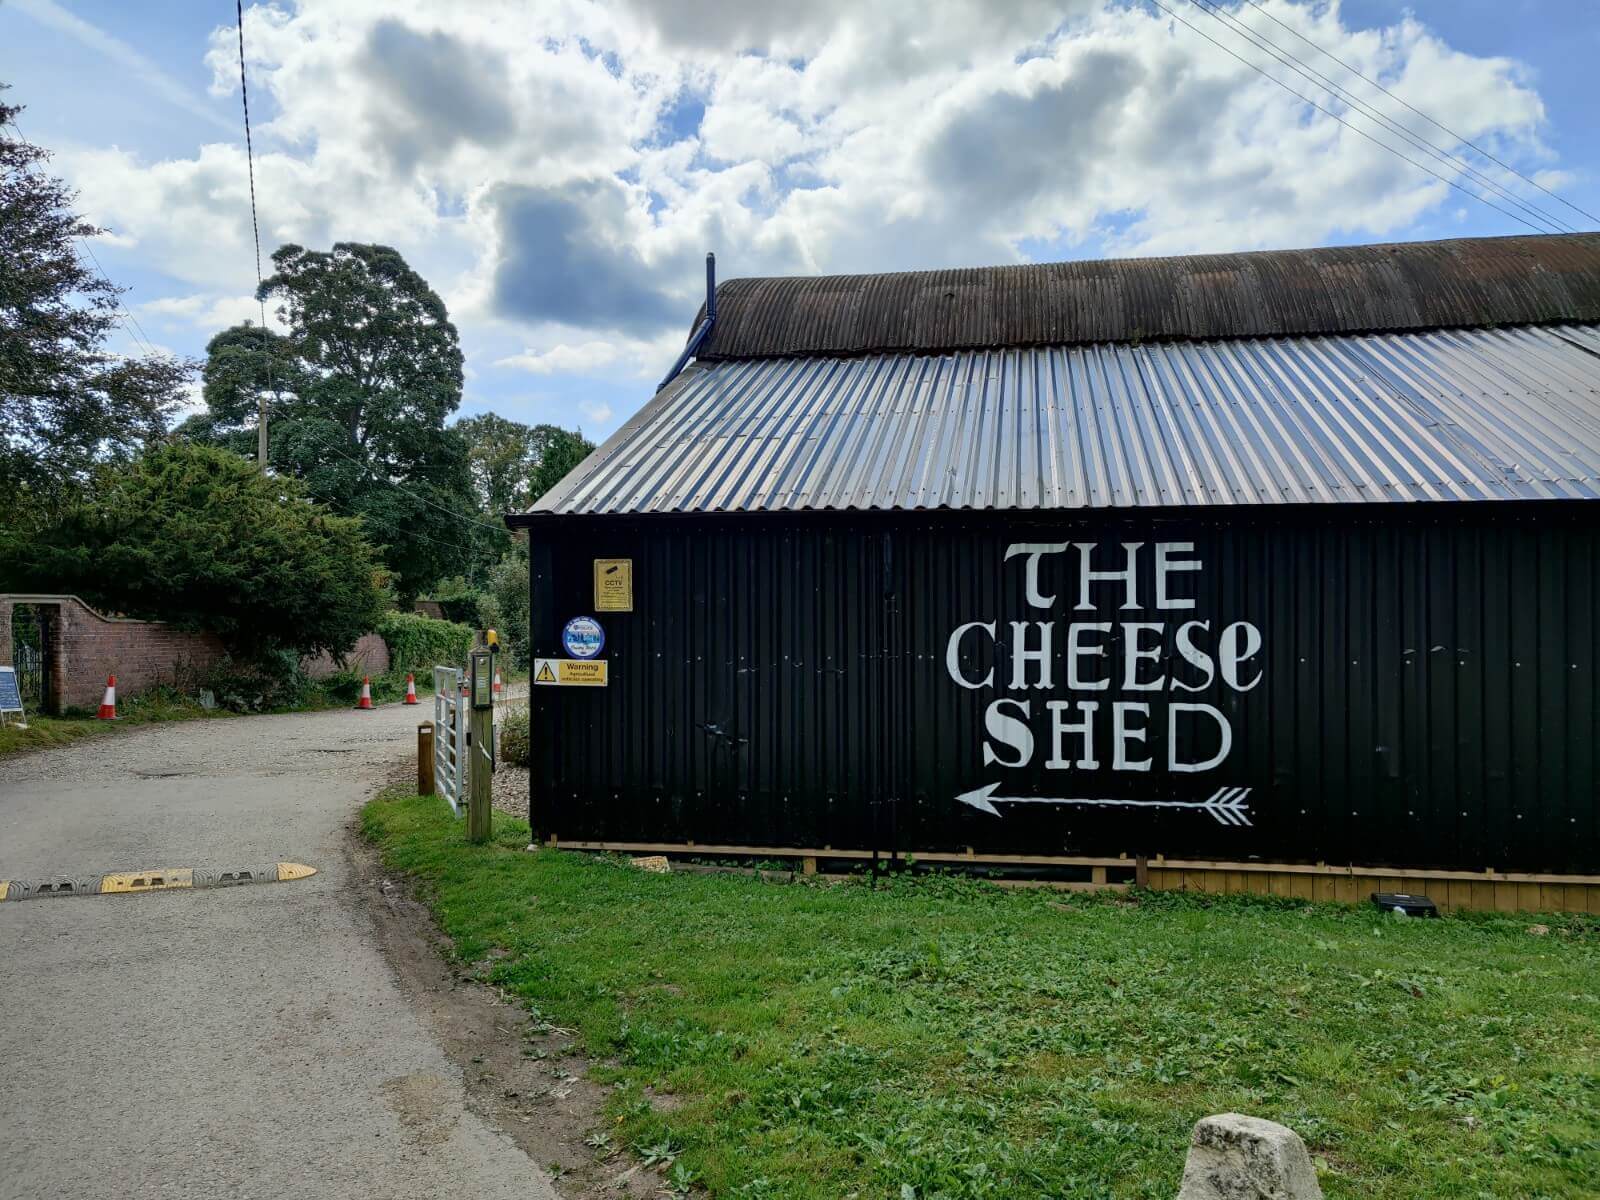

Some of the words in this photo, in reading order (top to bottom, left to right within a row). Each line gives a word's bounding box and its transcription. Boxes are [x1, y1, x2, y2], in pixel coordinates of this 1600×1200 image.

[1003, 541, 1203, 610] THE
[566, 663, 599, 671] Warning
[982, 697, 1232, 773] SHED
